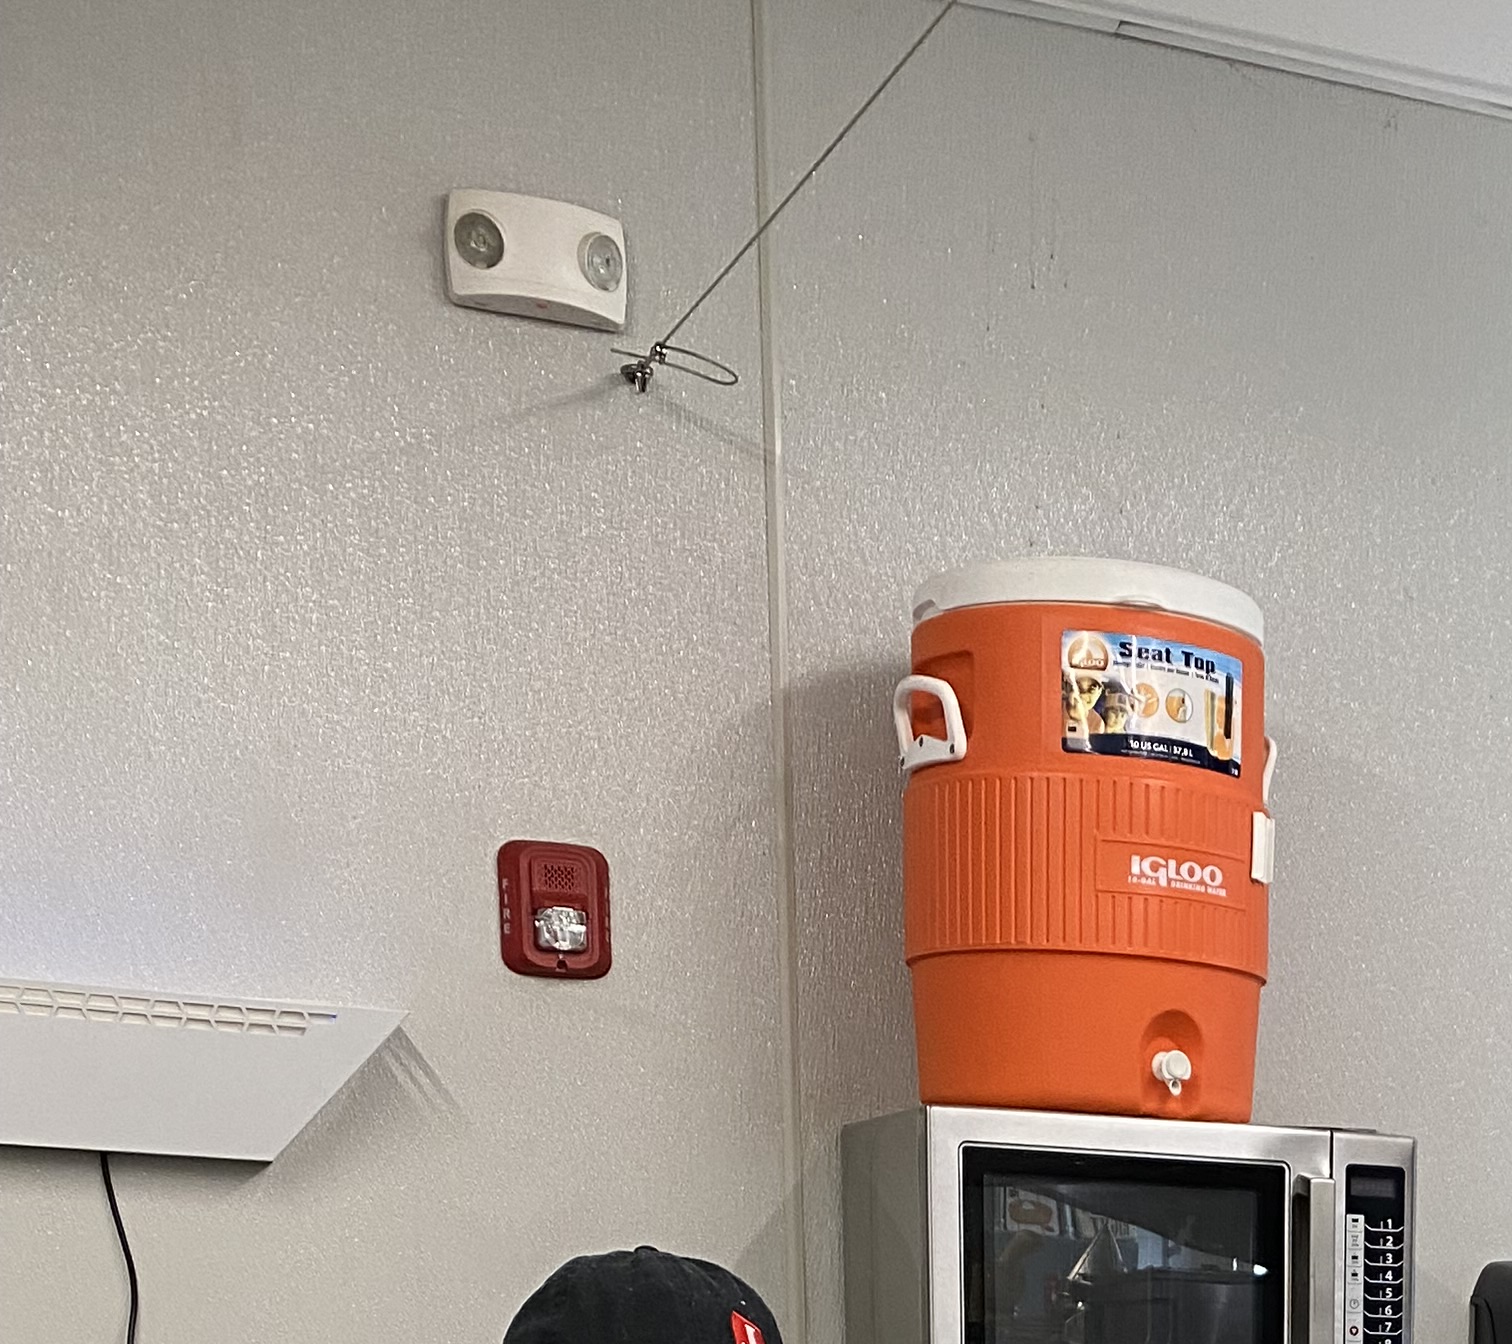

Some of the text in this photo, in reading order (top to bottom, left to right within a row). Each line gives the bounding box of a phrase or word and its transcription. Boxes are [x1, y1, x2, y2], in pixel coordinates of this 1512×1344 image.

[1181, 650, 1216, 675] Top
[1130, 854, 1223, 887] IGLOO
[501, 878, 511, 934] FIRE
[1387, 1218, 1393, 1230] 1
[1386, 1236, 1394, 1247] 2
[1385, 1253, 1393, 1264] 3
[1385, 1270, 1393, 1281] 4
[1385, 1287, 1393, 1298] 5
[1385, 1305, 1393, 1316] 6
[1384, 1322, 1392, 1333] 7
